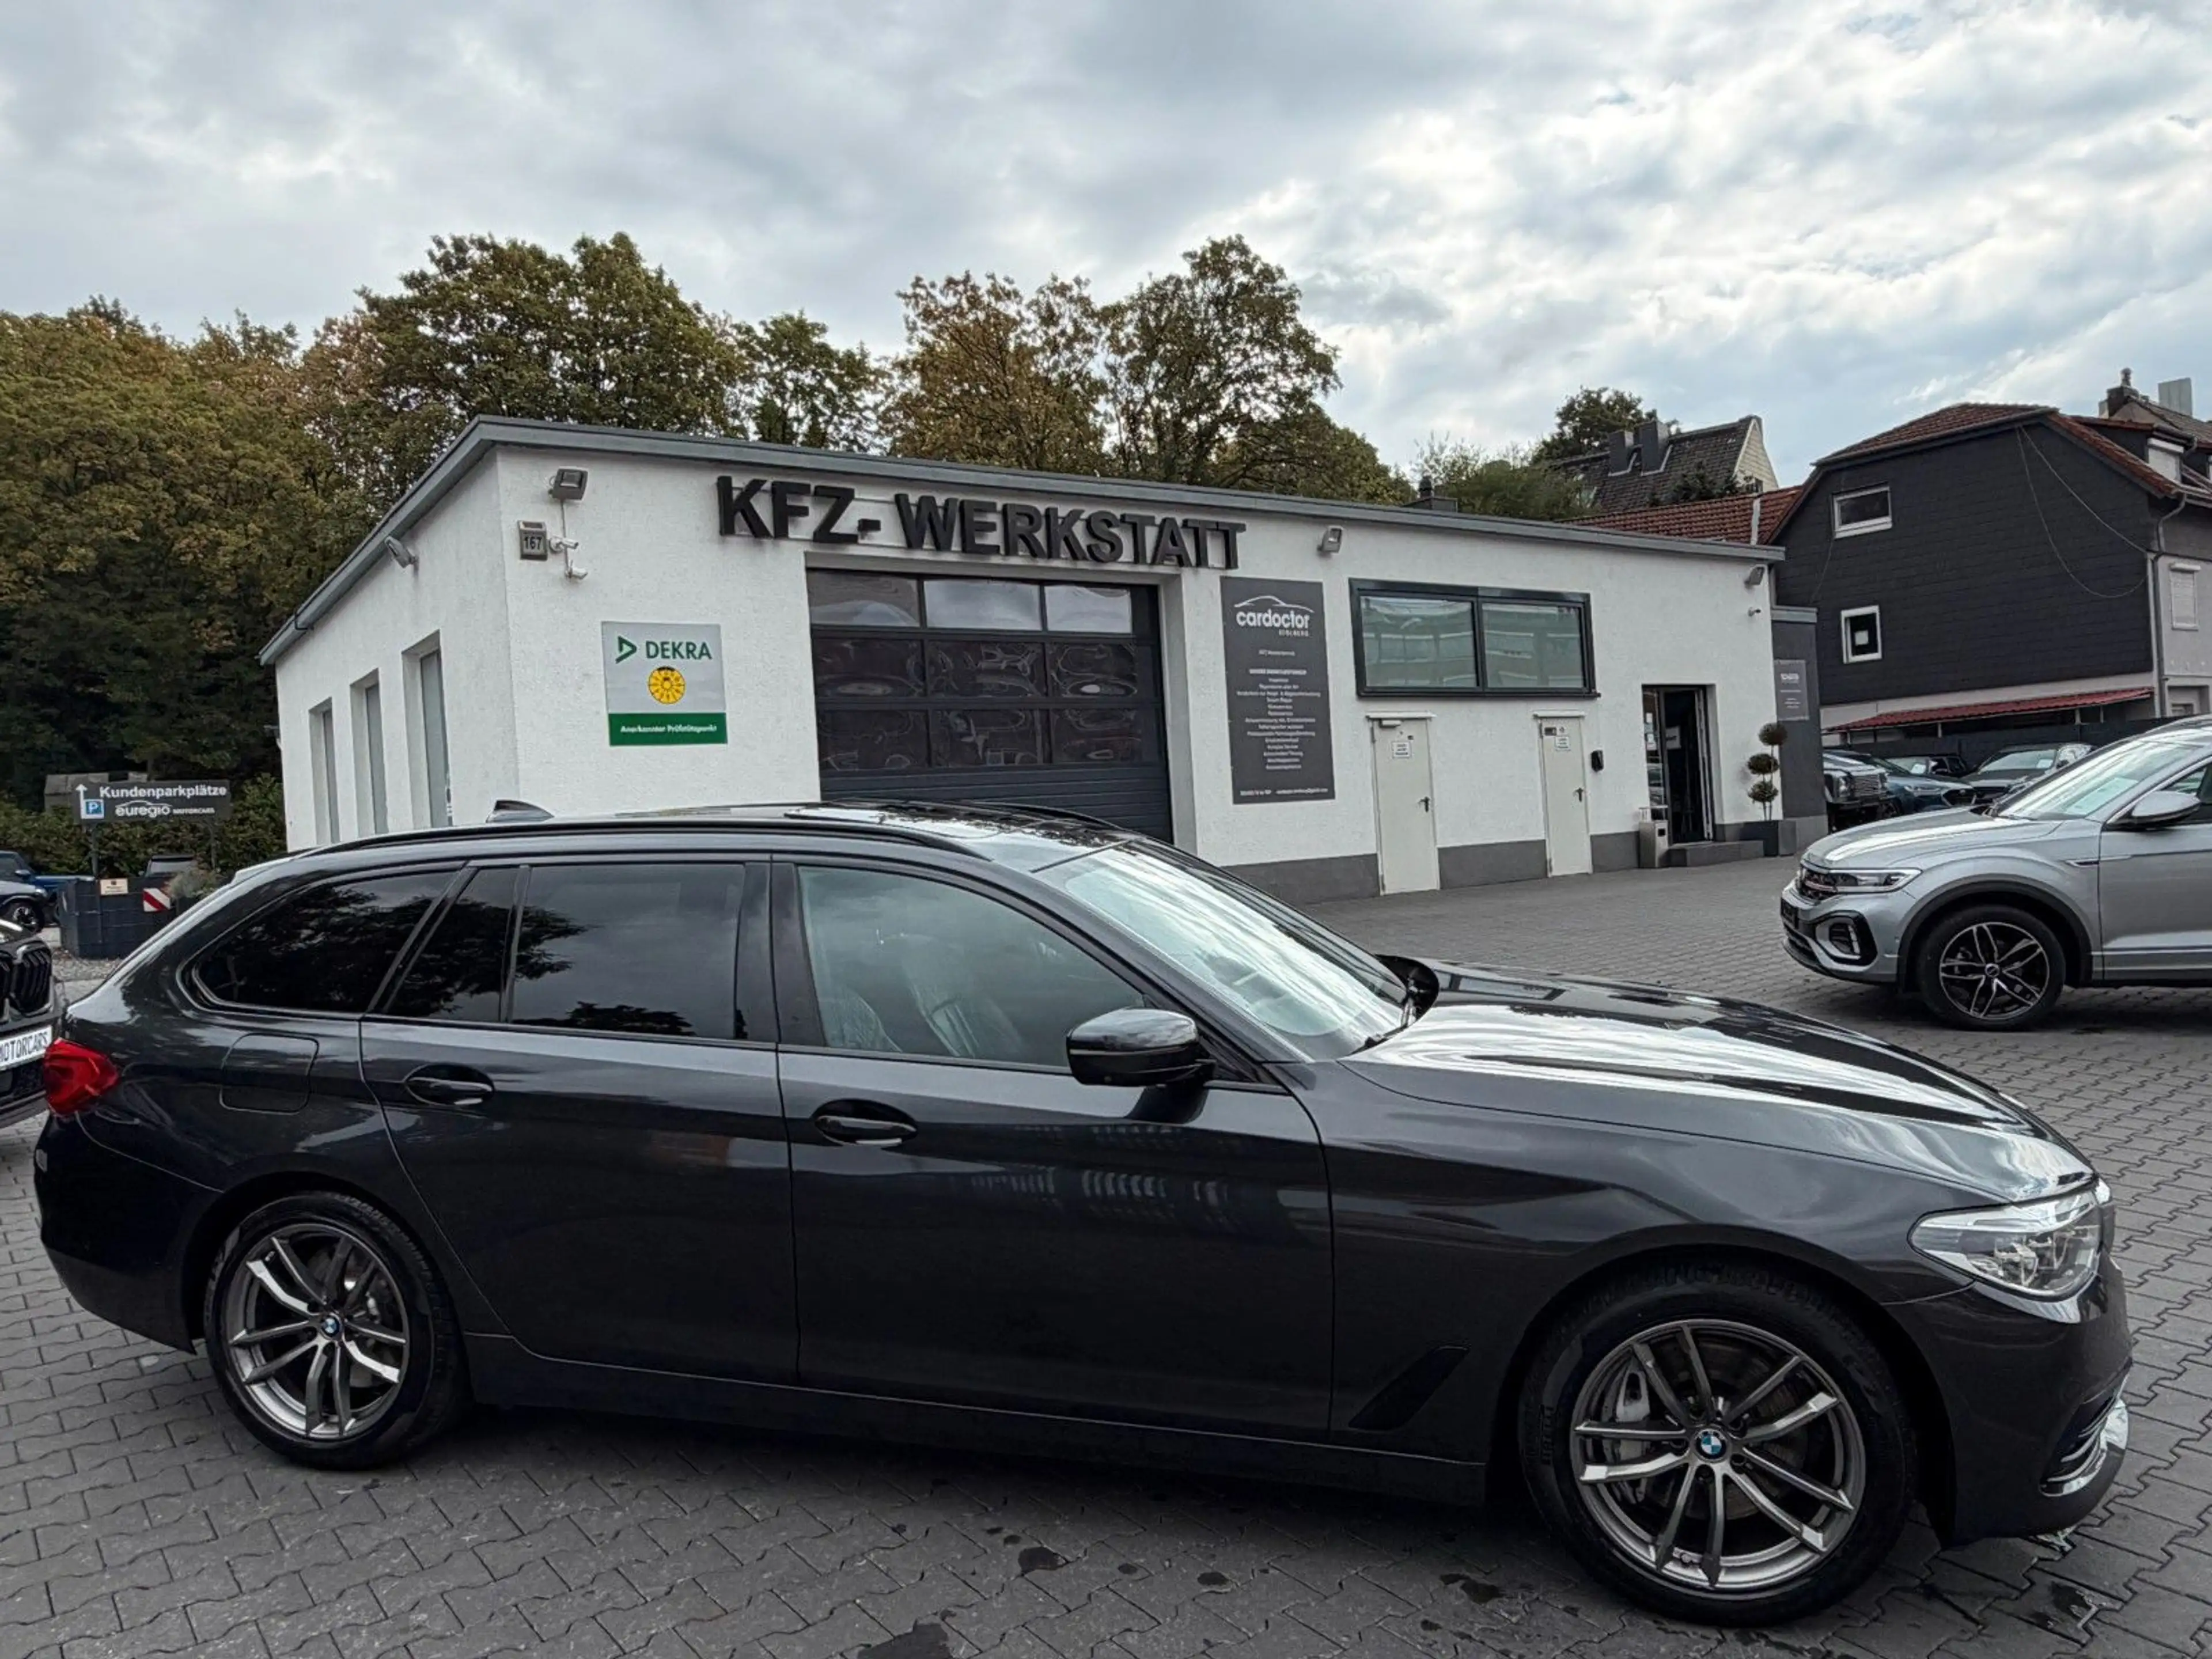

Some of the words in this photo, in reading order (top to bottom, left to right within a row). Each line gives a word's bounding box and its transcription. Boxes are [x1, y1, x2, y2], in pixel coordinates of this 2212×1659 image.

[894, 493, 1247, 570] WERKSTATT
[524, 536, 543, 550] 167
[1236, 608, 1310, 628] cardoctor
[645, 640, 713, 660] DEKRA
[99, 785, 228, 800] Kundenparkplätze
[88, 801, 99, 814] P
[115, 805, 170, 818] euregio
